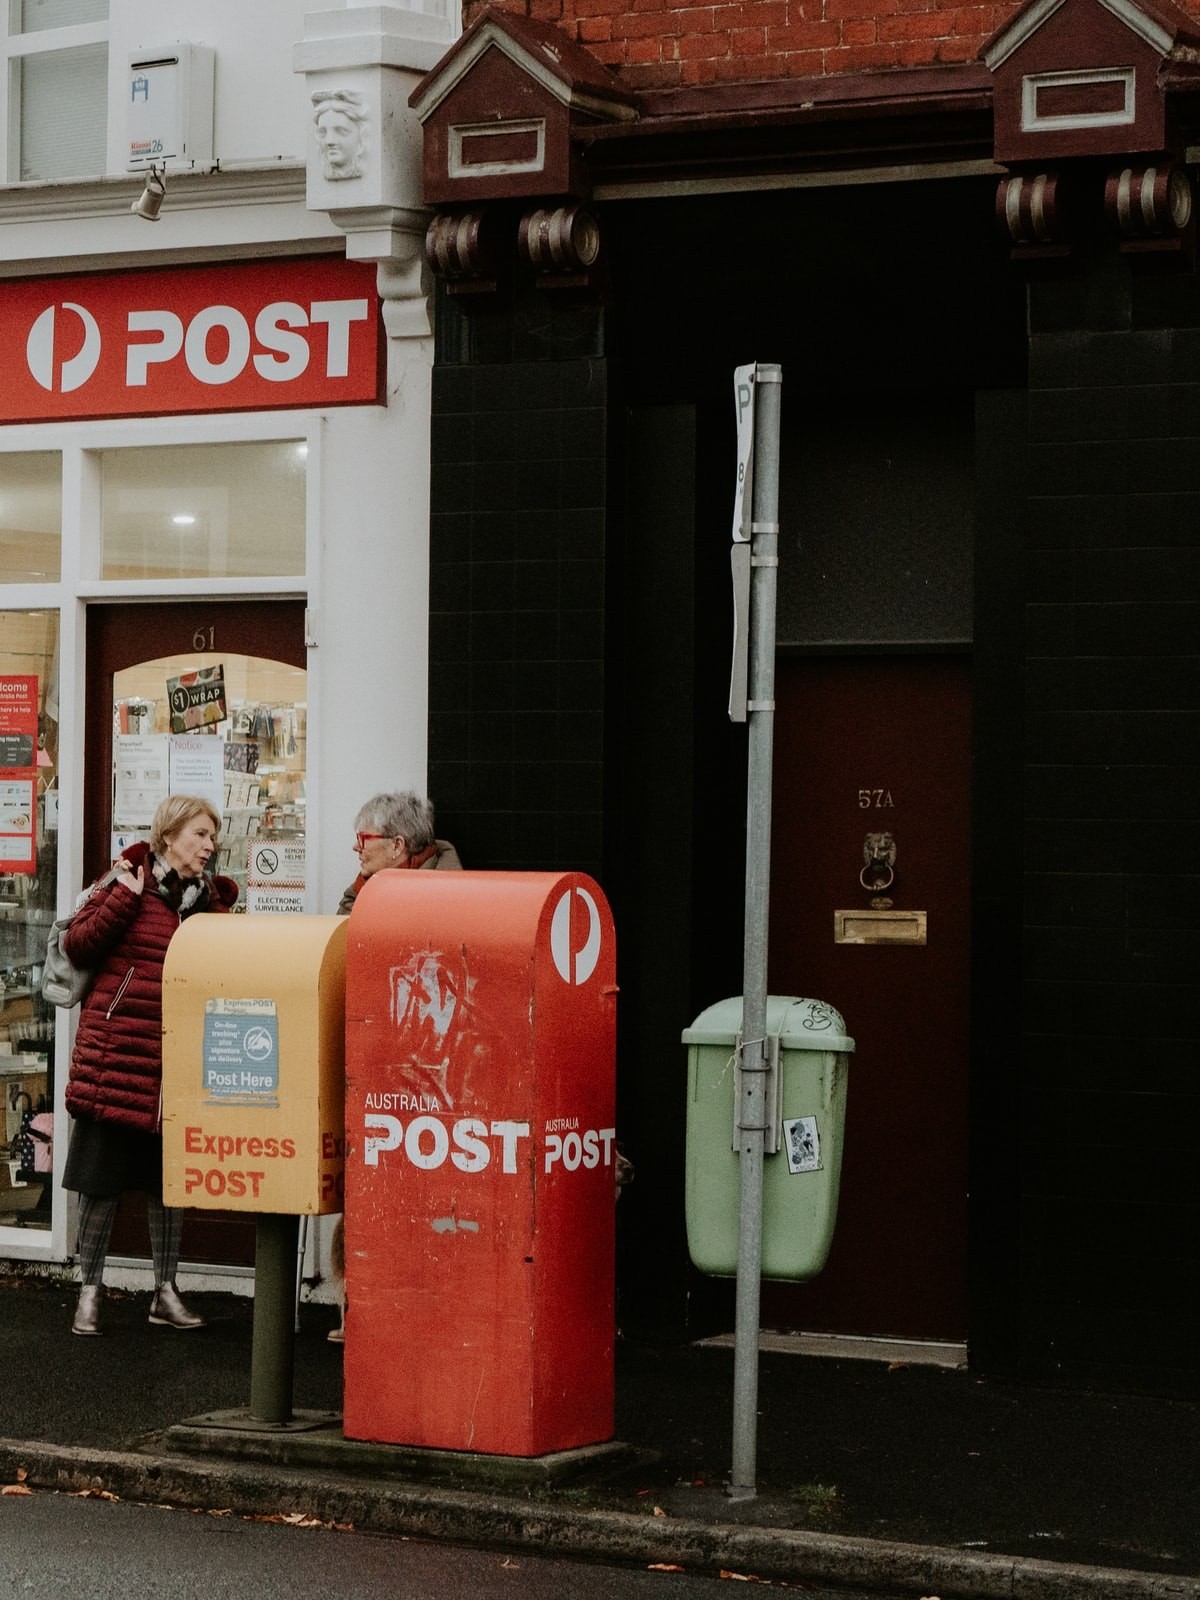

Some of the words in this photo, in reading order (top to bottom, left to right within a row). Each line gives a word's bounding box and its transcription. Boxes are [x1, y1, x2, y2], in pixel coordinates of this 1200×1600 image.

[152, 139, 163, 153] 26
[126, 298, 368, 387] POST
[738, 383, 751, 424] P
[193, 625, 215, 651] 61
[174, 692, 184, 708] $1
[191, 688, 220, 705] WRAP
[175, 741, 202, 750] Notice
[858, 789, 895, 808] 57A
[254, 904, 304, 912] SURVEILLANCE
[257, 896, 301, 904] ELECTRONIC
[211, 1047, 240, 1055] signature
[218, 1055, 243, 1064] delivery
[208, 1070, 238, 1086] Post
[240, 1071, 273, 1087] Here
[365, 1092, 440, 1112] AUSTRALIA
[545, 1117, 579, 1132] AUSTRALIA
[185, 1126, 296, 1162] Express
[365, 1113, 530, 1174] POST
[544, 1127, 616, 1174] POST
[185, 1168, 265, 1198] POST
